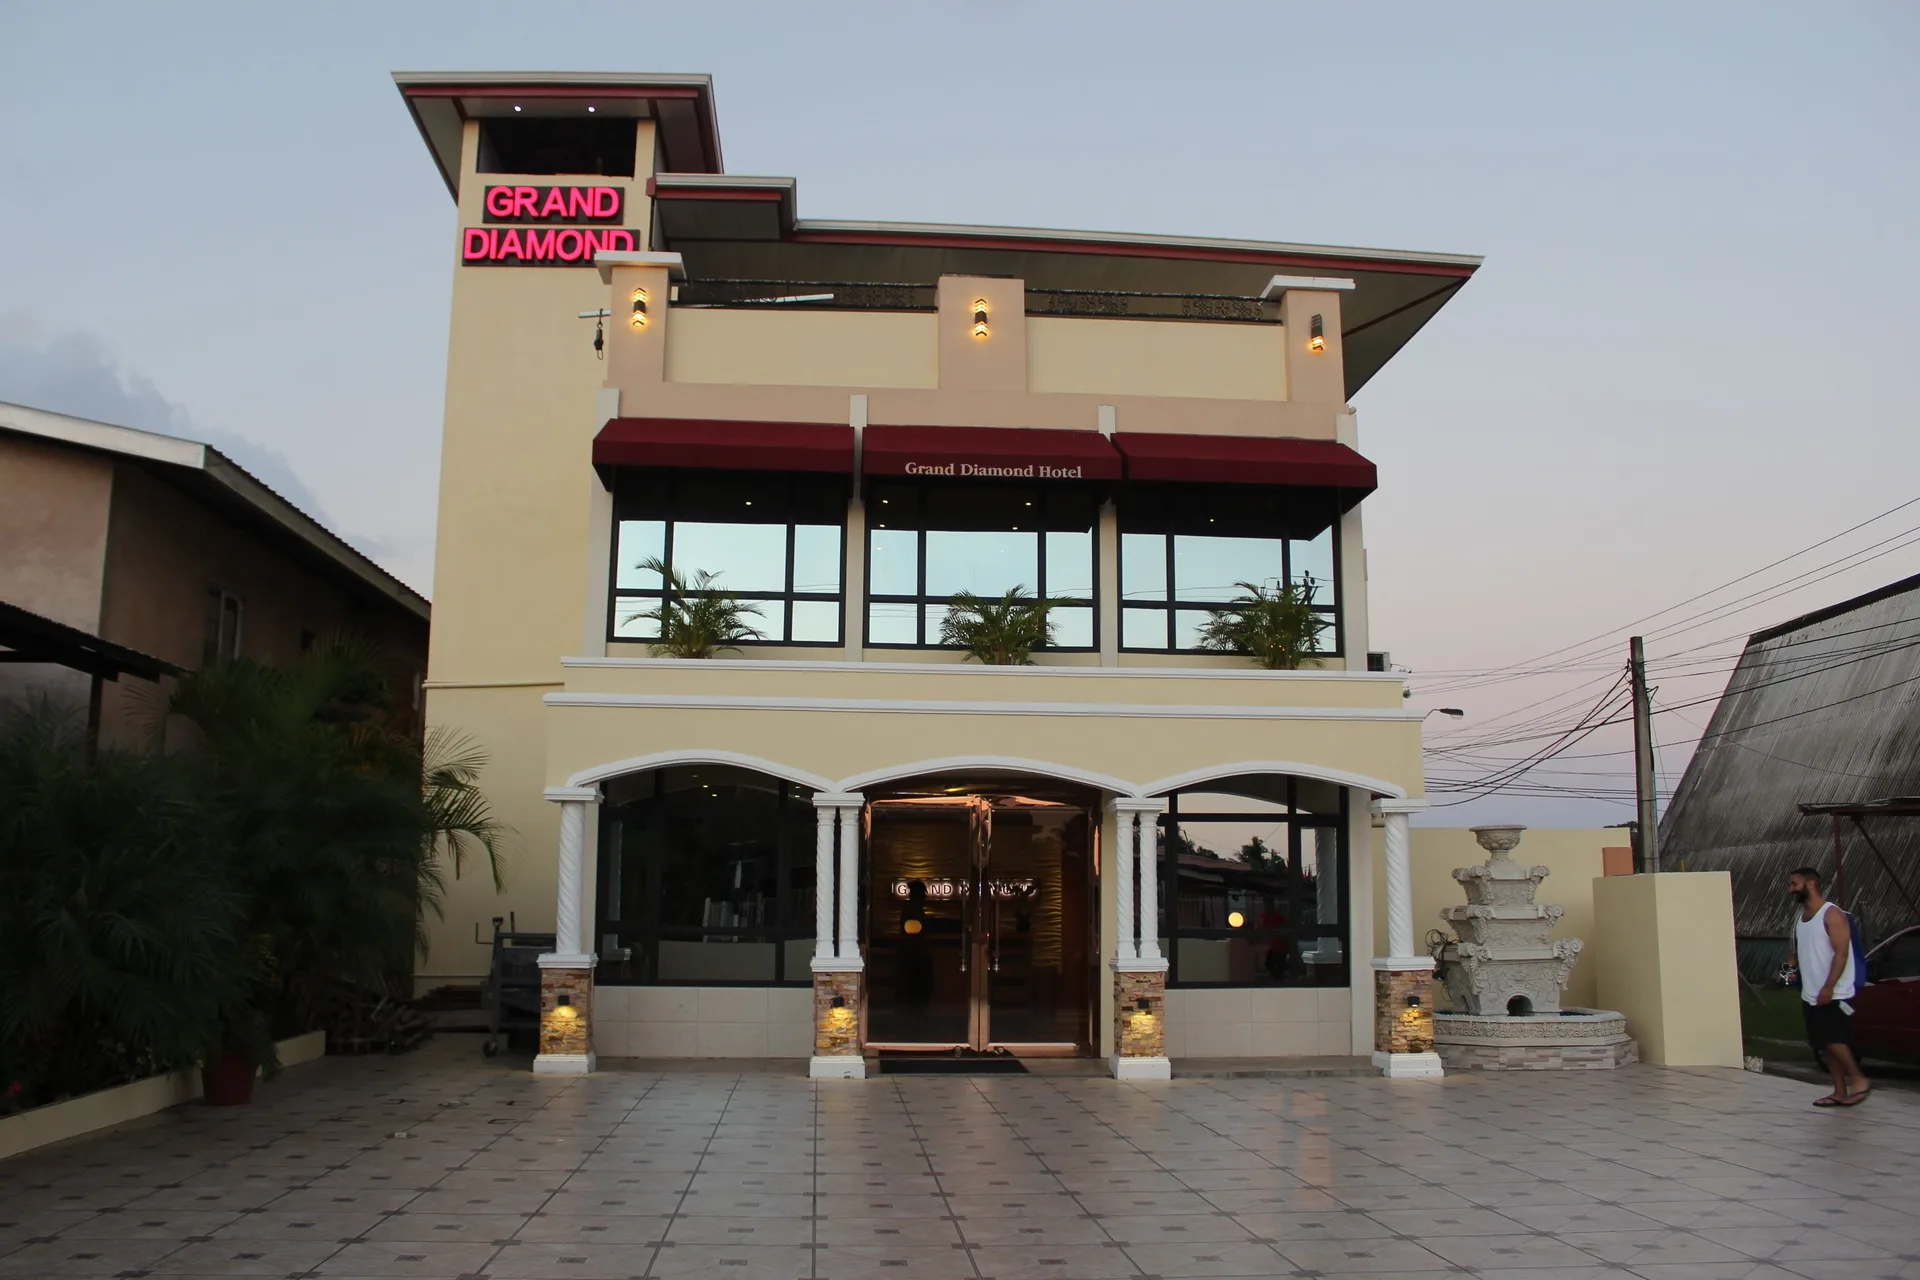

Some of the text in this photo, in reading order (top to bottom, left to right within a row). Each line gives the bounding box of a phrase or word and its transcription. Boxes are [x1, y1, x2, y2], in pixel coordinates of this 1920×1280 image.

[486, 185, 620, 218] GRAND
[463, 228, 635, 261] DIAMOND
[904, 462, 1083, 479] Grand Diamond Hotel
[897, 883, 952, 895] GND
